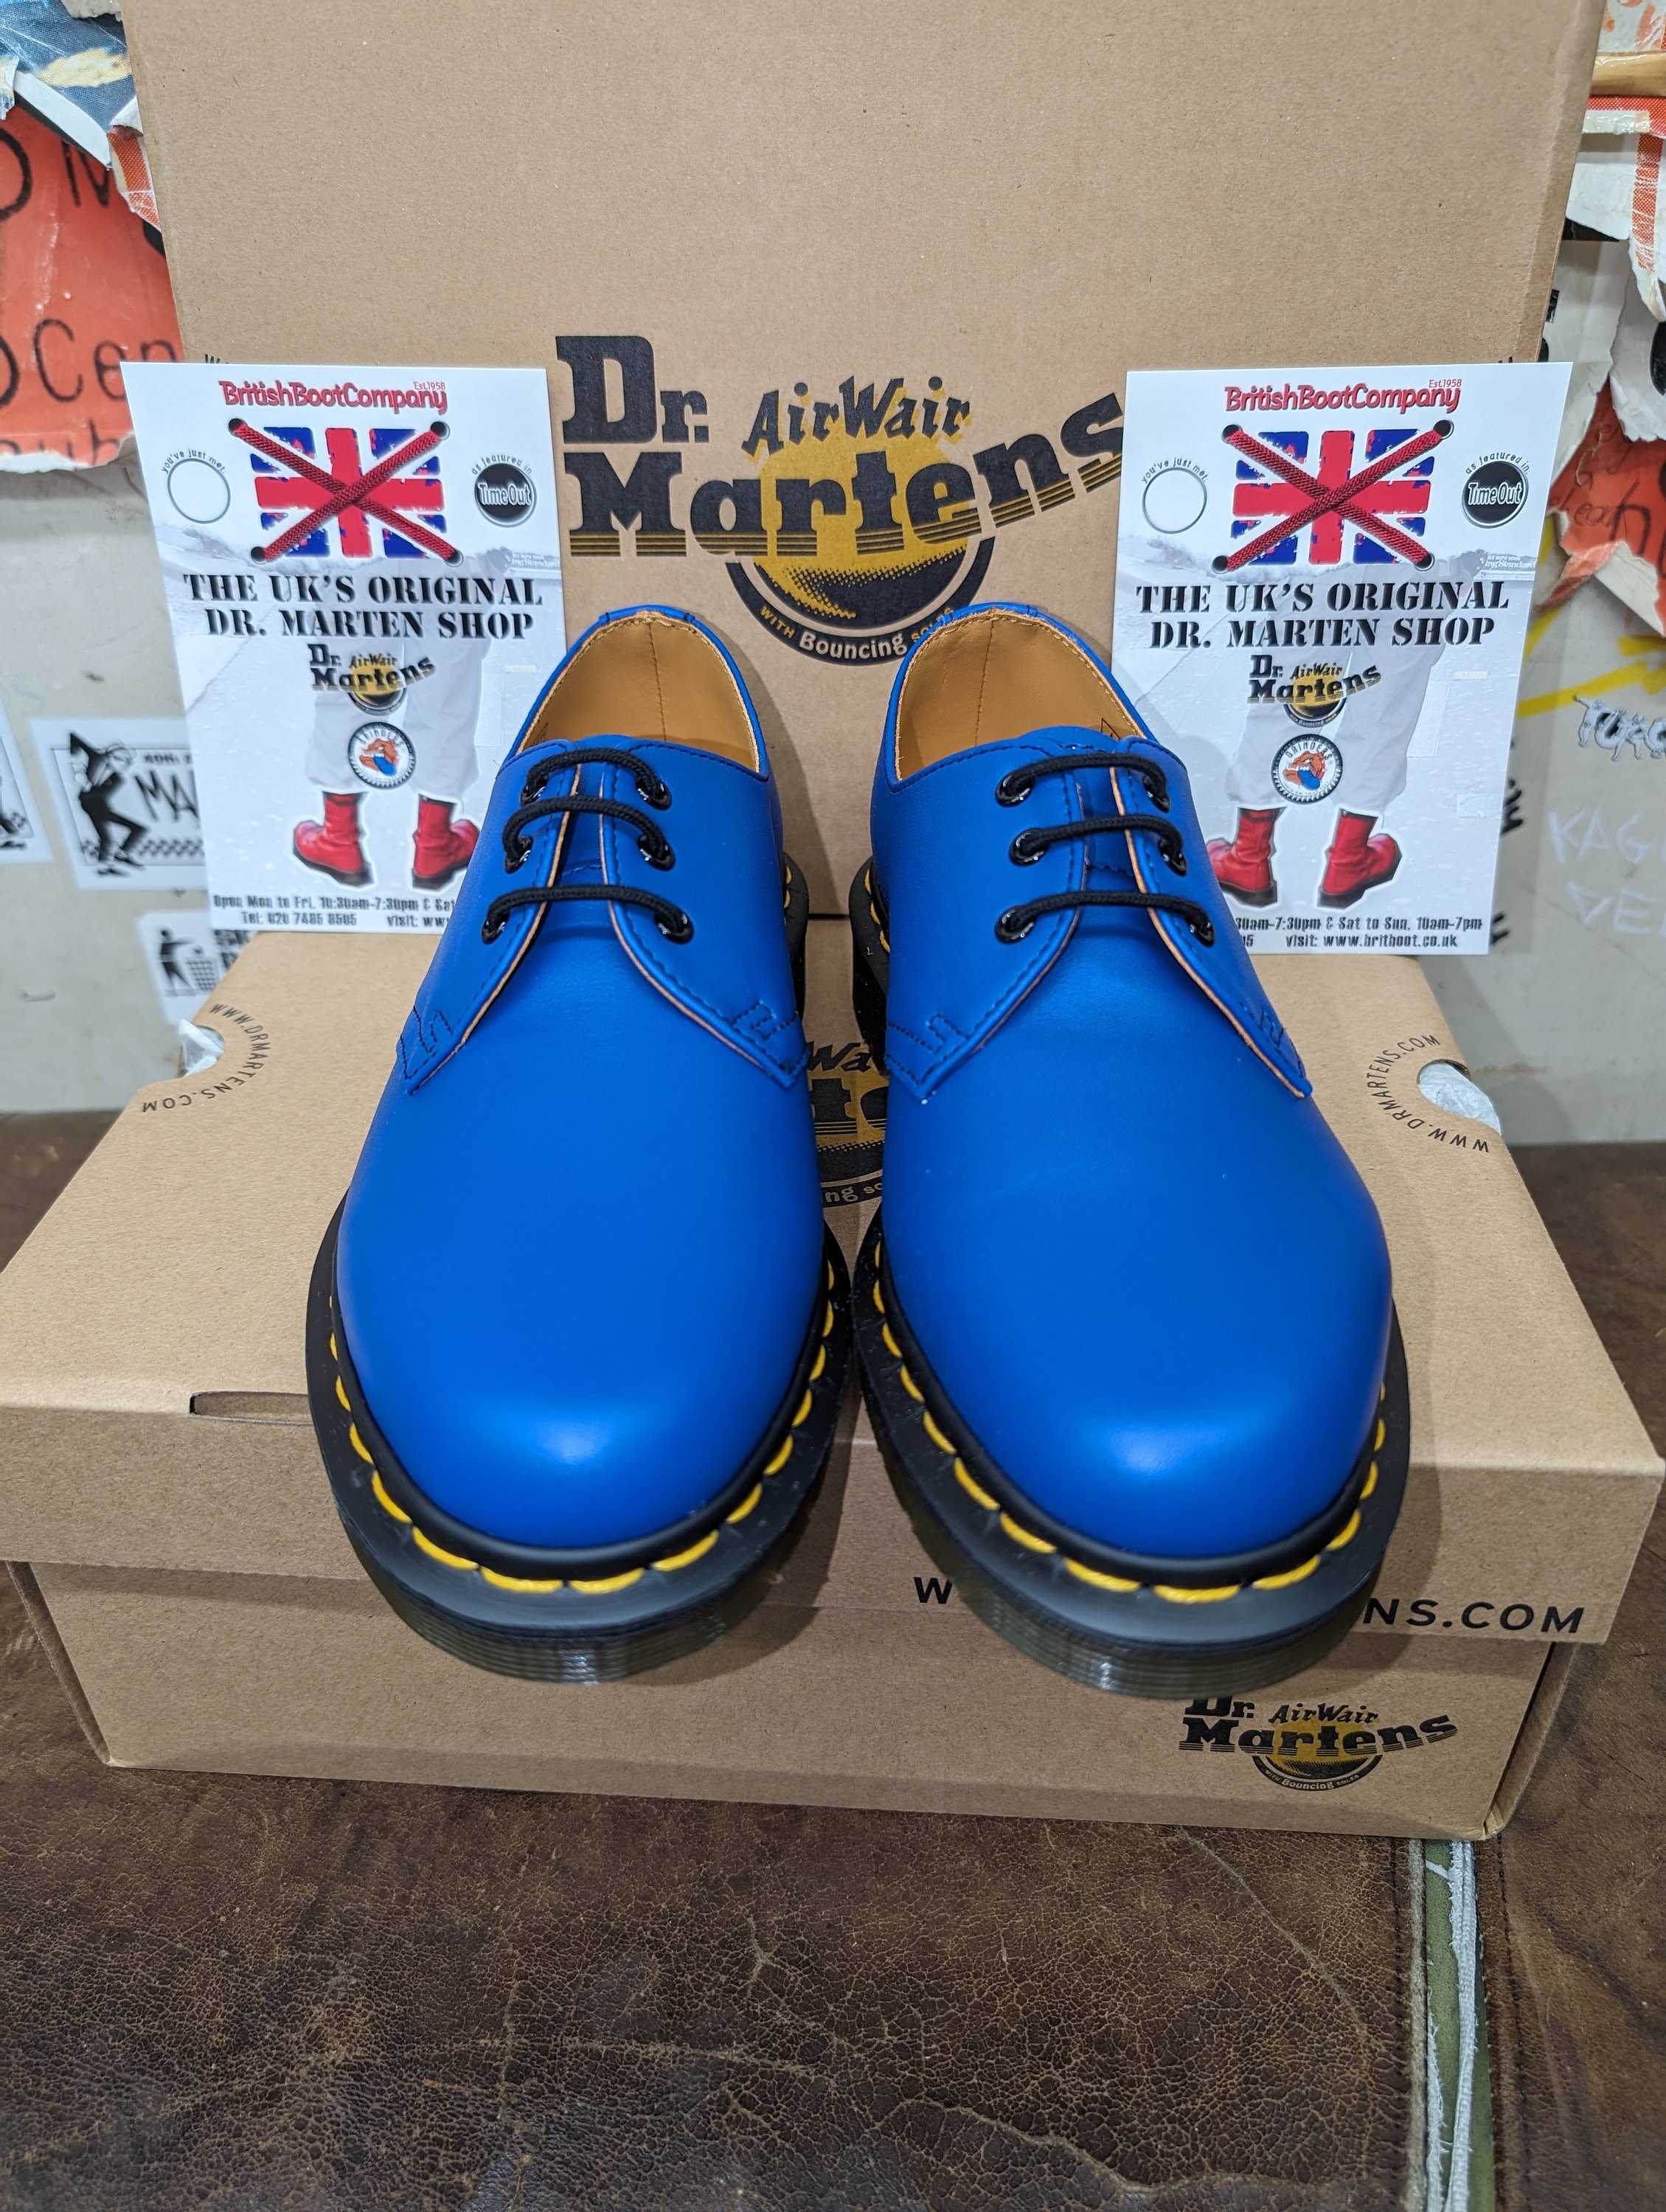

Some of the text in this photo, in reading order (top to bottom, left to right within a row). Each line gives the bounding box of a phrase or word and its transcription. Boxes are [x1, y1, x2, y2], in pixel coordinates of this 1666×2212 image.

[556, 336, 709, 444] Dr.
[741, 376, 971, 457] AirWair
[162, 451, 185, 474] you've
[188, 448, 206, 460] just
[471, 464, 482, 475] as
[482, 454, 523, 466] featured
[564, 393, 1122, 557] Martens
[1141, 460, 1169, 484] you've
[1173, 456, 1192, 468] just
[1465, 463, 1476, 475] as
[1479, 451, 1522, 465] featured
[183, 574, 543, 606] THE UK'S ORIGINAL
[1136, 581, 1510, 614] THE UK'S ORIGINAL
[205, 608, 534, 639] DR. MARTEN SHOP
[760, 605, 908, 660] WITH Bouncing
[1149, 617, 1495, 649] DR. MARTEN SHOP
[308, 644, 342, 667] Dr.
[350, 653, 398, 669] AirWair
[1249, 654, 1283, 678] Dr.
[310, 657, 436, 692] Martens
[1247, 665, 1381, 704] Martens
[1289, 662, 1343, 680] AirWair
[212, 894, 242, 908] Open
[248, 895, 273, 908] Mon
[277, 896, 289, 908] to
[268, 912, 290, 925] 020
[1337, 917, 1361, 931] Sat
[1366, 917, 1379, 931] to
[1285, 933, 1458, 948] visit: www.britboot.co.uk
[142, 1004, 271, 1113] WWW.DRMARTENS.COM
[1367, 1034, 1489, 1153] WWW.DRMARTENS.COM
[1362, 1597, 1584, 1634] NS.COM
[1184, 1696, 1254, 1719] Dr.
[1268, 1703, 1378, 1725] AirWair
[1179, 1714, 1458, 1757] Martens
[1282, 1778, 1333, 1790] Bouncing
[1336, 1773, 1360, 1787] SOLES
